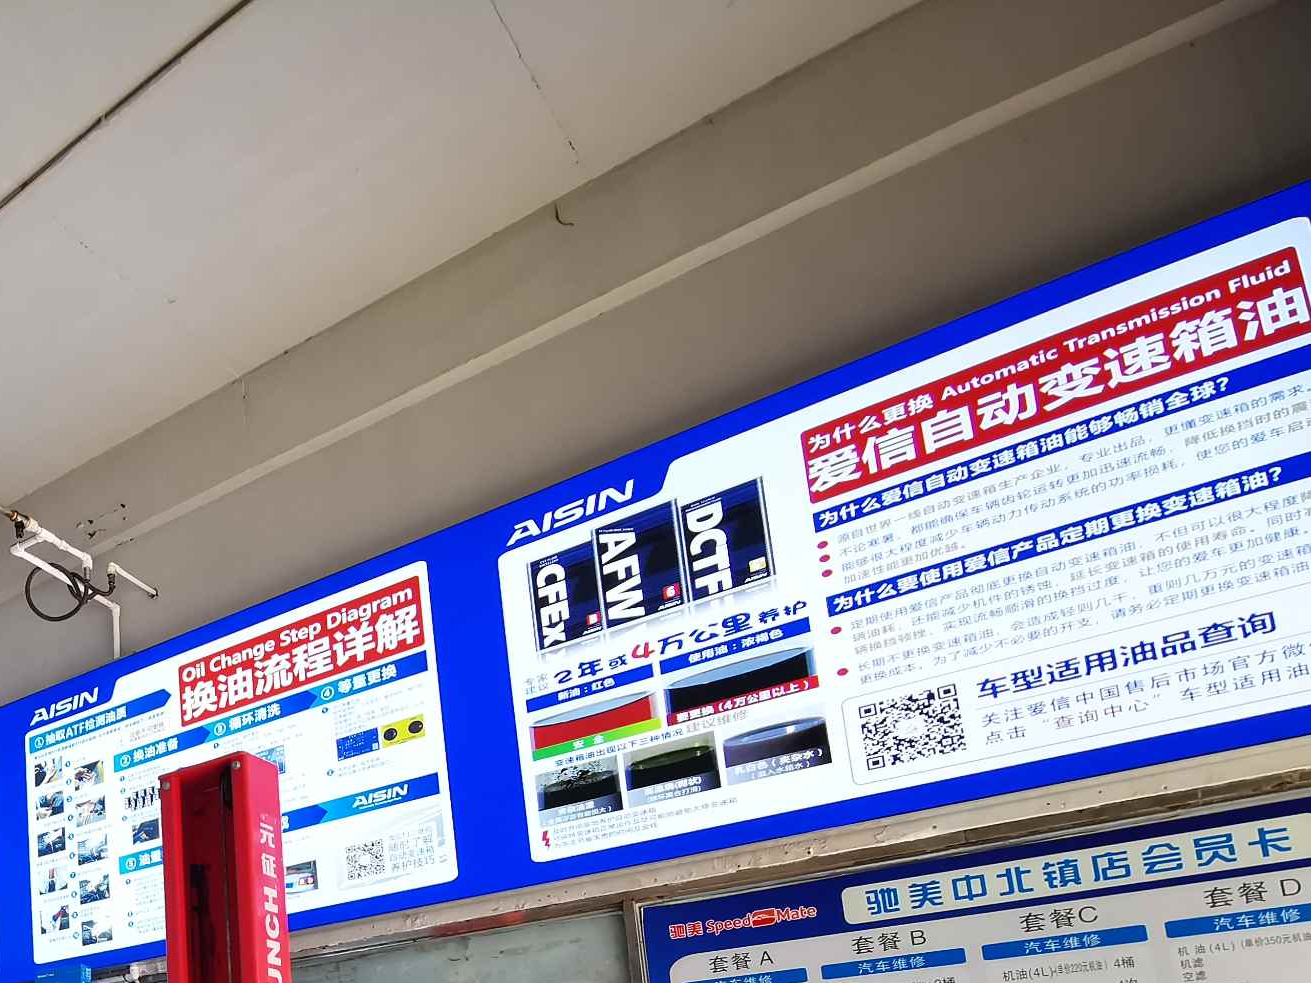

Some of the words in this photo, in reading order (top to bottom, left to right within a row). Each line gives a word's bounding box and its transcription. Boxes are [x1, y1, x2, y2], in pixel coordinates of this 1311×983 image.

[808, 393, 934, 453] 为什么更换
[941, 348, 1059, 401] Automatic
[1063, 289, 1221, 352] Transmission
[1228, 260, 1291, 294] Fluid
[808, 287, 1311, 493] 爱信自动变速箱油
[506, 479, 634, 546] AISIN
[686, 501, 733, 595] DCTF
[598, 532, 645, 620] AFW
[537, 564, 570, 648] CFEX
[182, 664, 205, 682] Oil
[209, 639, 275, 671] Change
[280, 622, 321, 649] Step
[327, 588, 412, 628] Diagram
[977, 611, 1277, 698] 车型适用油品查询
[182, 604, 421, 721] 换油流程详解
[982, 640, 1311, 727] 关注爱信中国售后市场官方微
[30, 687, 98, 726] AISIN
[133, 738, 178, 761] 换油准备
[353, 783, 409, 809] AISIN
[864, 826, 1293, 916] 驰美中北镇店会员卡
[1280, 878, 1302, 897] D
[669, 922, 703, 940] 驰美
[706, 914, 752, 936] Speed
[777, 906, 817, 923] Mate
[910, 929, 927, 946] B
[1019, 906, 1098, 932] 套餐C
[1024, 933, 1102, 954] 汽车维修
[1213, 908, 1302, 931] 汽车维修
[708, 952, 751, 974] 套餐
[759, 950, 774, 966] A
[858, 956, 927, 974] 汽车维修
